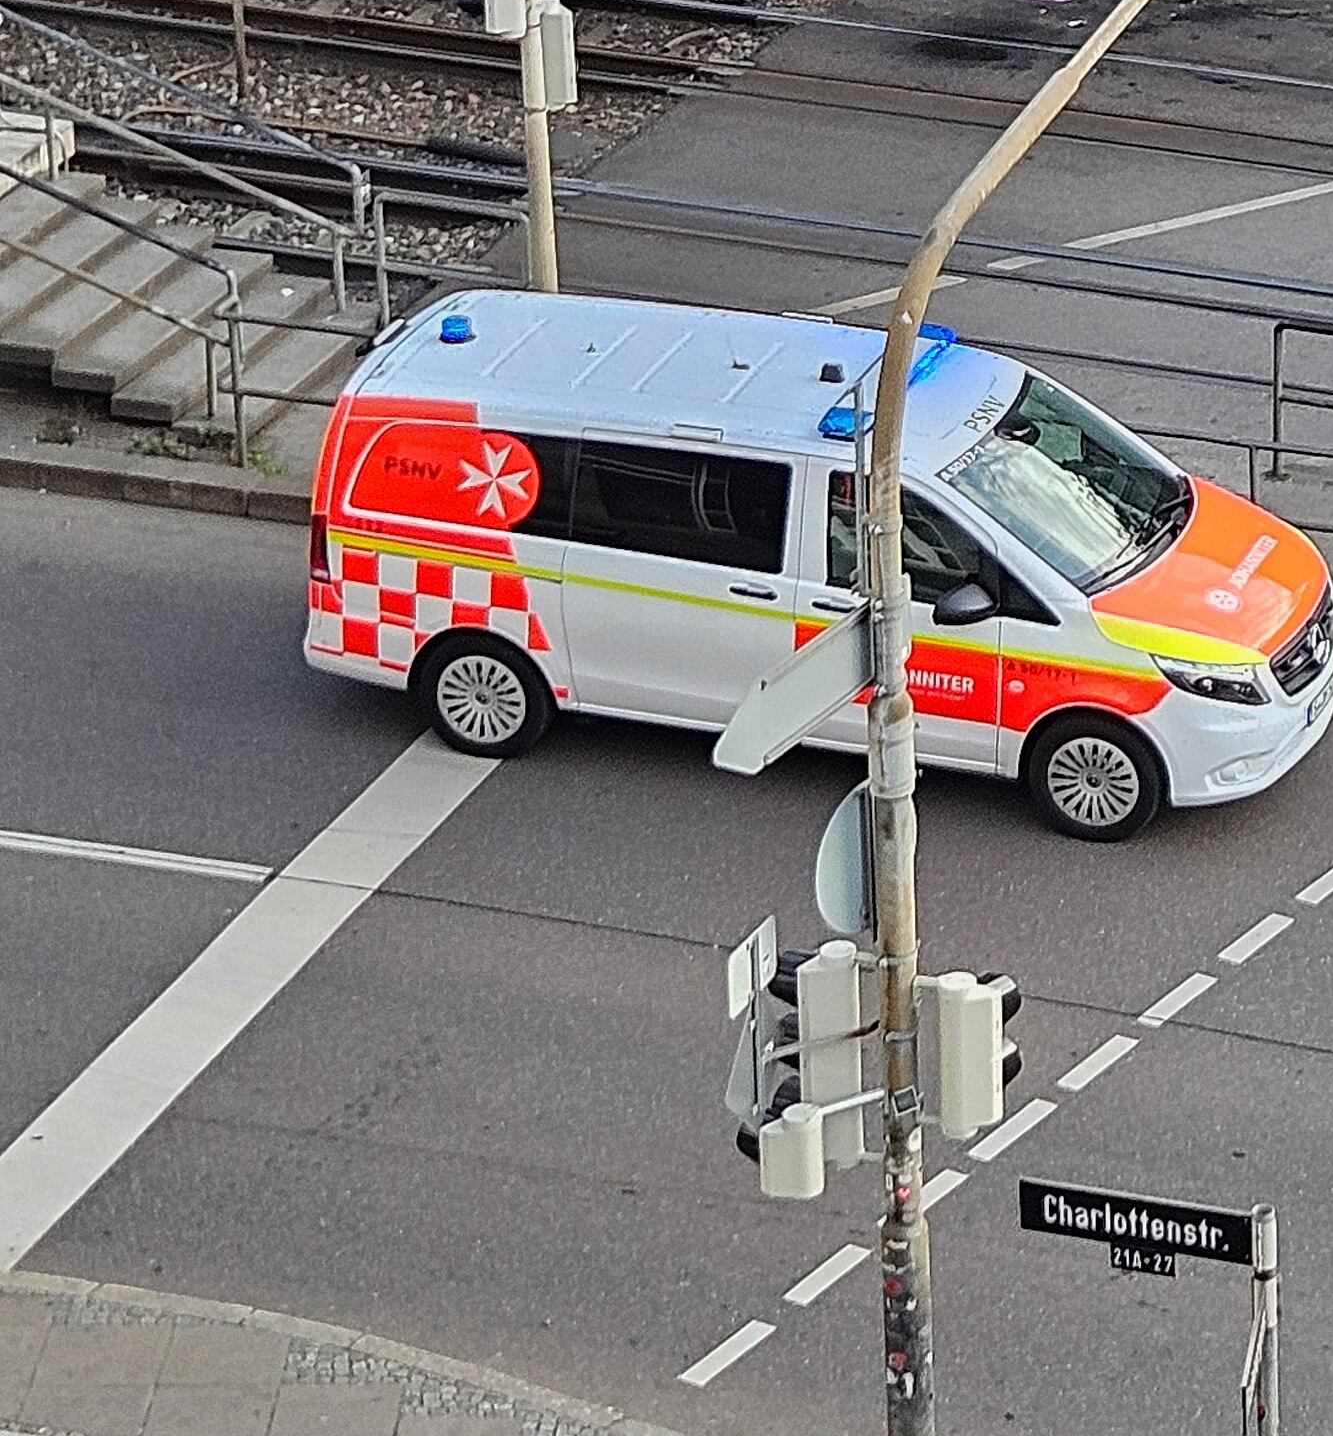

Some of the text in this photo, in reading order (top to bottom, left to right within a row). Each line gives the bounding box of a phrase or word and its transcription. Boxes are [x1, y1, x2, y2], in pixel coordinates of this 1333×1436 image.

[963, 393, 1006, 433] PSNV
[383, 454, 442, 481] PSNV
[908, 668, 975, 694] NNITER
[1043, 1193, 1230, 1253] Charlottenstr.
